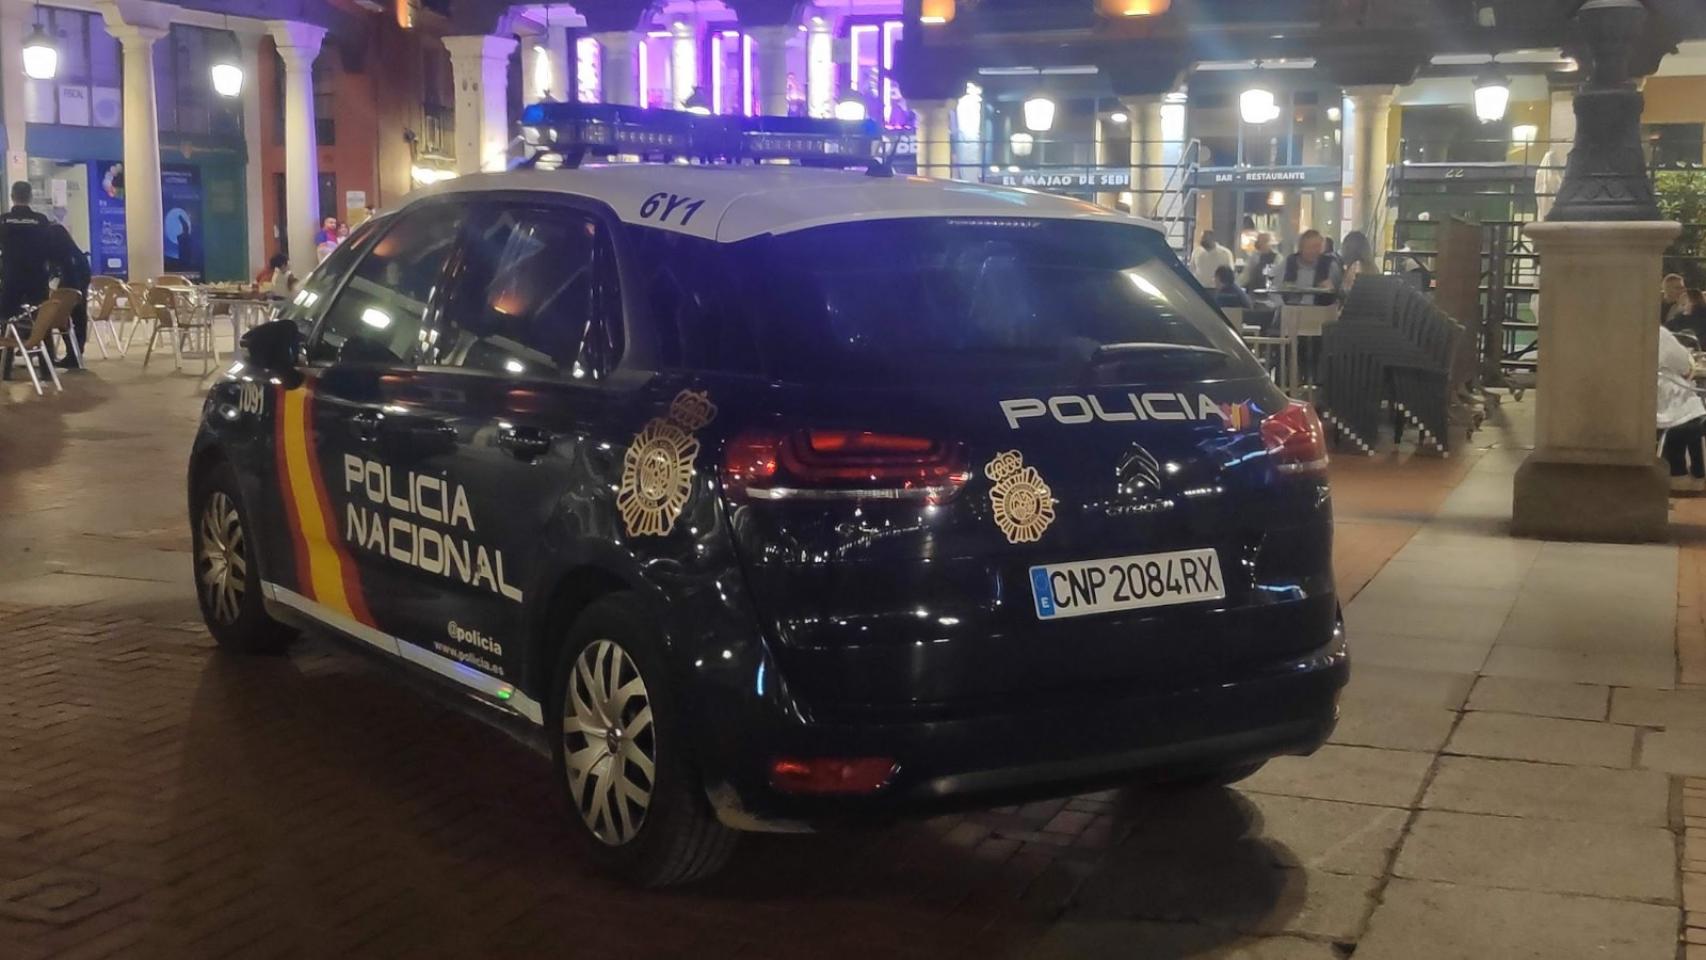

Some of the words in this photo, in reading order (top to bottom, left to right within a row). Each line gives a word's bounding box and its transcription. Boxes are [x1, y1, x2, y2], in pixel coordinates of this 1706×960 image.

[1003, 175, 1017, 186] EL
[1079, 174, 1096, 186] DE
[1215, 174, 1233, 182] BAR
[1246, 172, 1306, 181] RESTAURANTE
[1445, 167, 1464, 179] 22
[640, 191, 706, 226] 6Y1
[1000, 393, 1229, 429] POLICIA
[346, 501, 523, 603] NACIONAL
[1041, 596, 1051, 609] E
[447, 620, 503, 656] @policia
